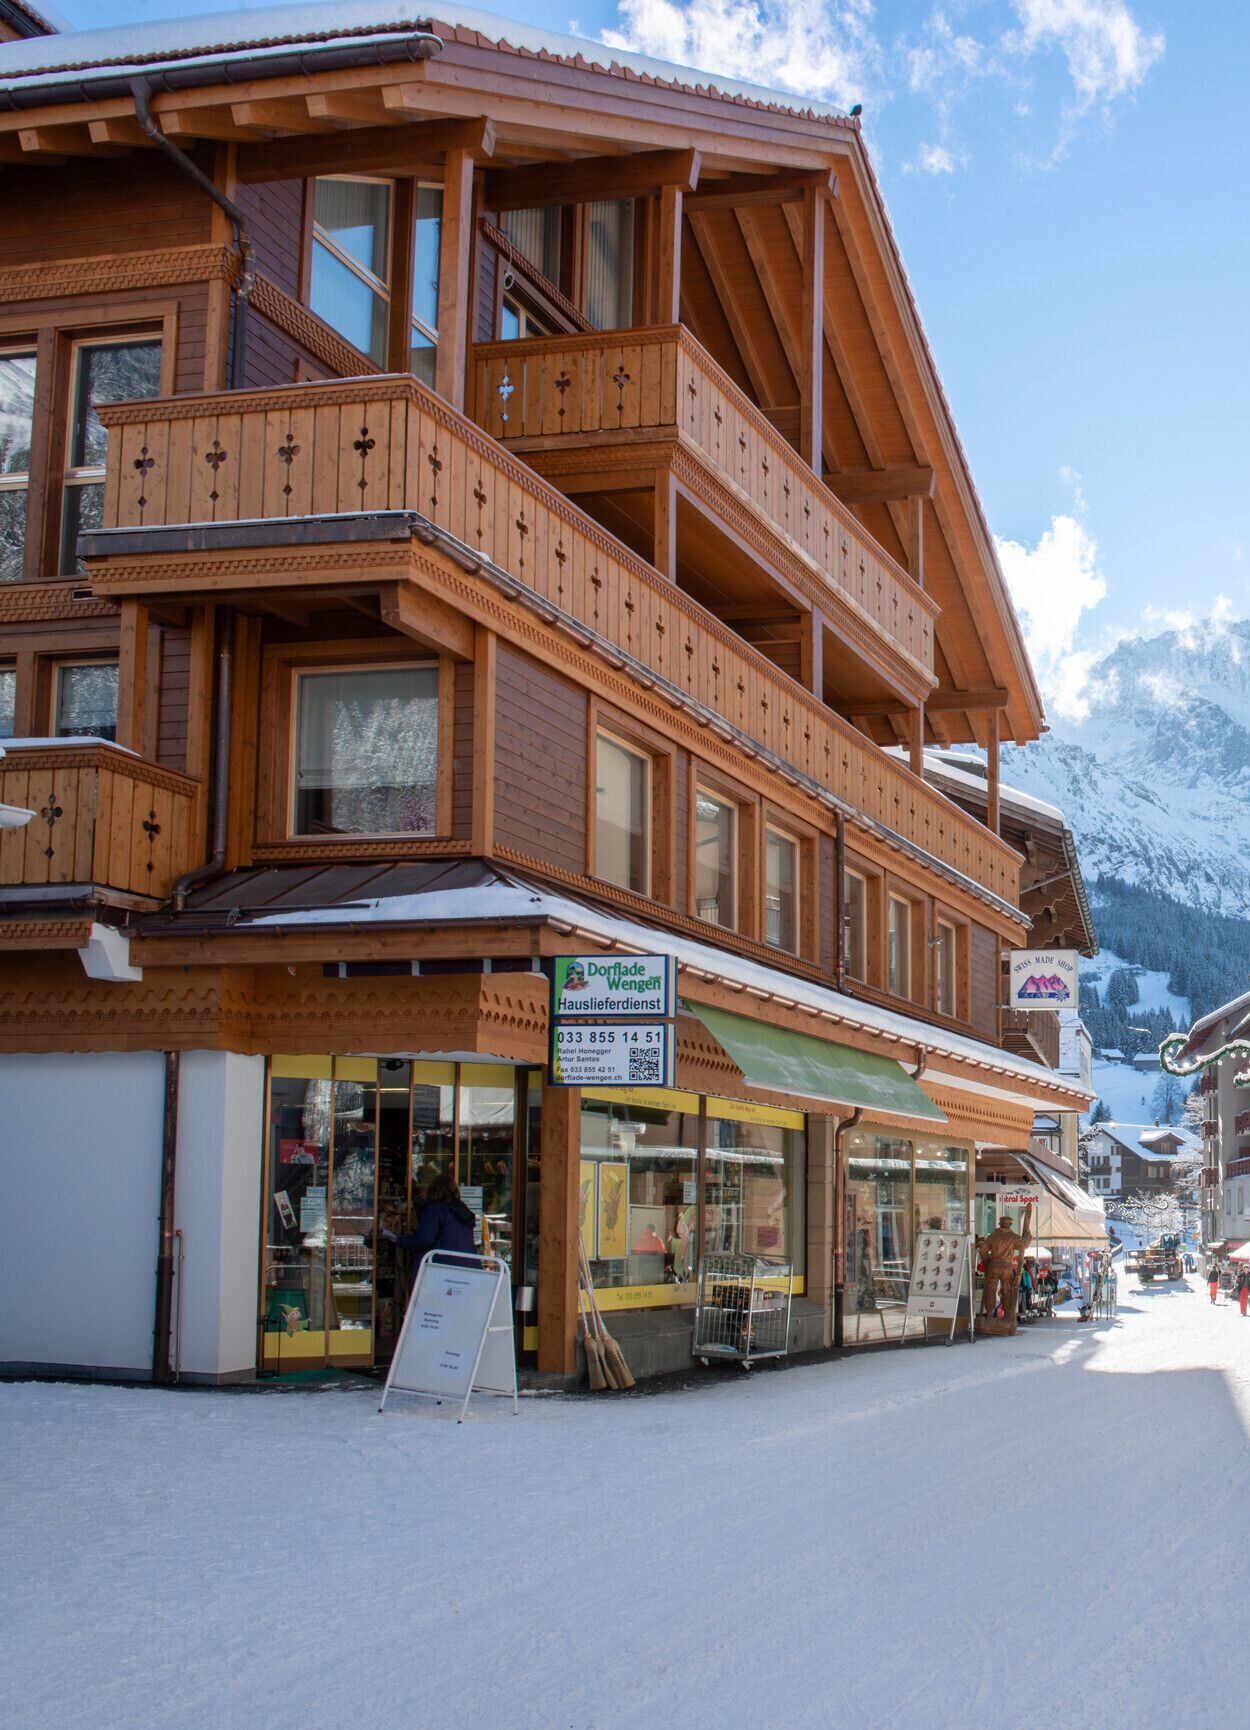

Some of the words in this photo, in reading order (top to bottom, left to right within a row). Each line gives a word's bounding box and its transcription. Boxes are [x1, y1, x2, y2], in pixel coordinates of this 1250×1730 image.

[587, 962, 645, 976] Dorflade
[1013, 958, 1032, 974] SWISS
[1035, 956, 1054, 964] MADE
[1057, 959, 1074, 973] SHOP
[607, 976, 660, 993] Wengen
[558, 997, 661, 1010] Hauslieferdienst
[557, 1031, 582, 1043] 033
[590, 1031, 615, 1043] 855
[622, 1031, 638, 1043] 14
[645, 1031, 661, 1043] 51
[578, 1048, 611, 1056] Honegger
[556, 1074, 622, 1082] dorflade-wengen.ch
[1019, 1195, 1039, 1204] Sport
